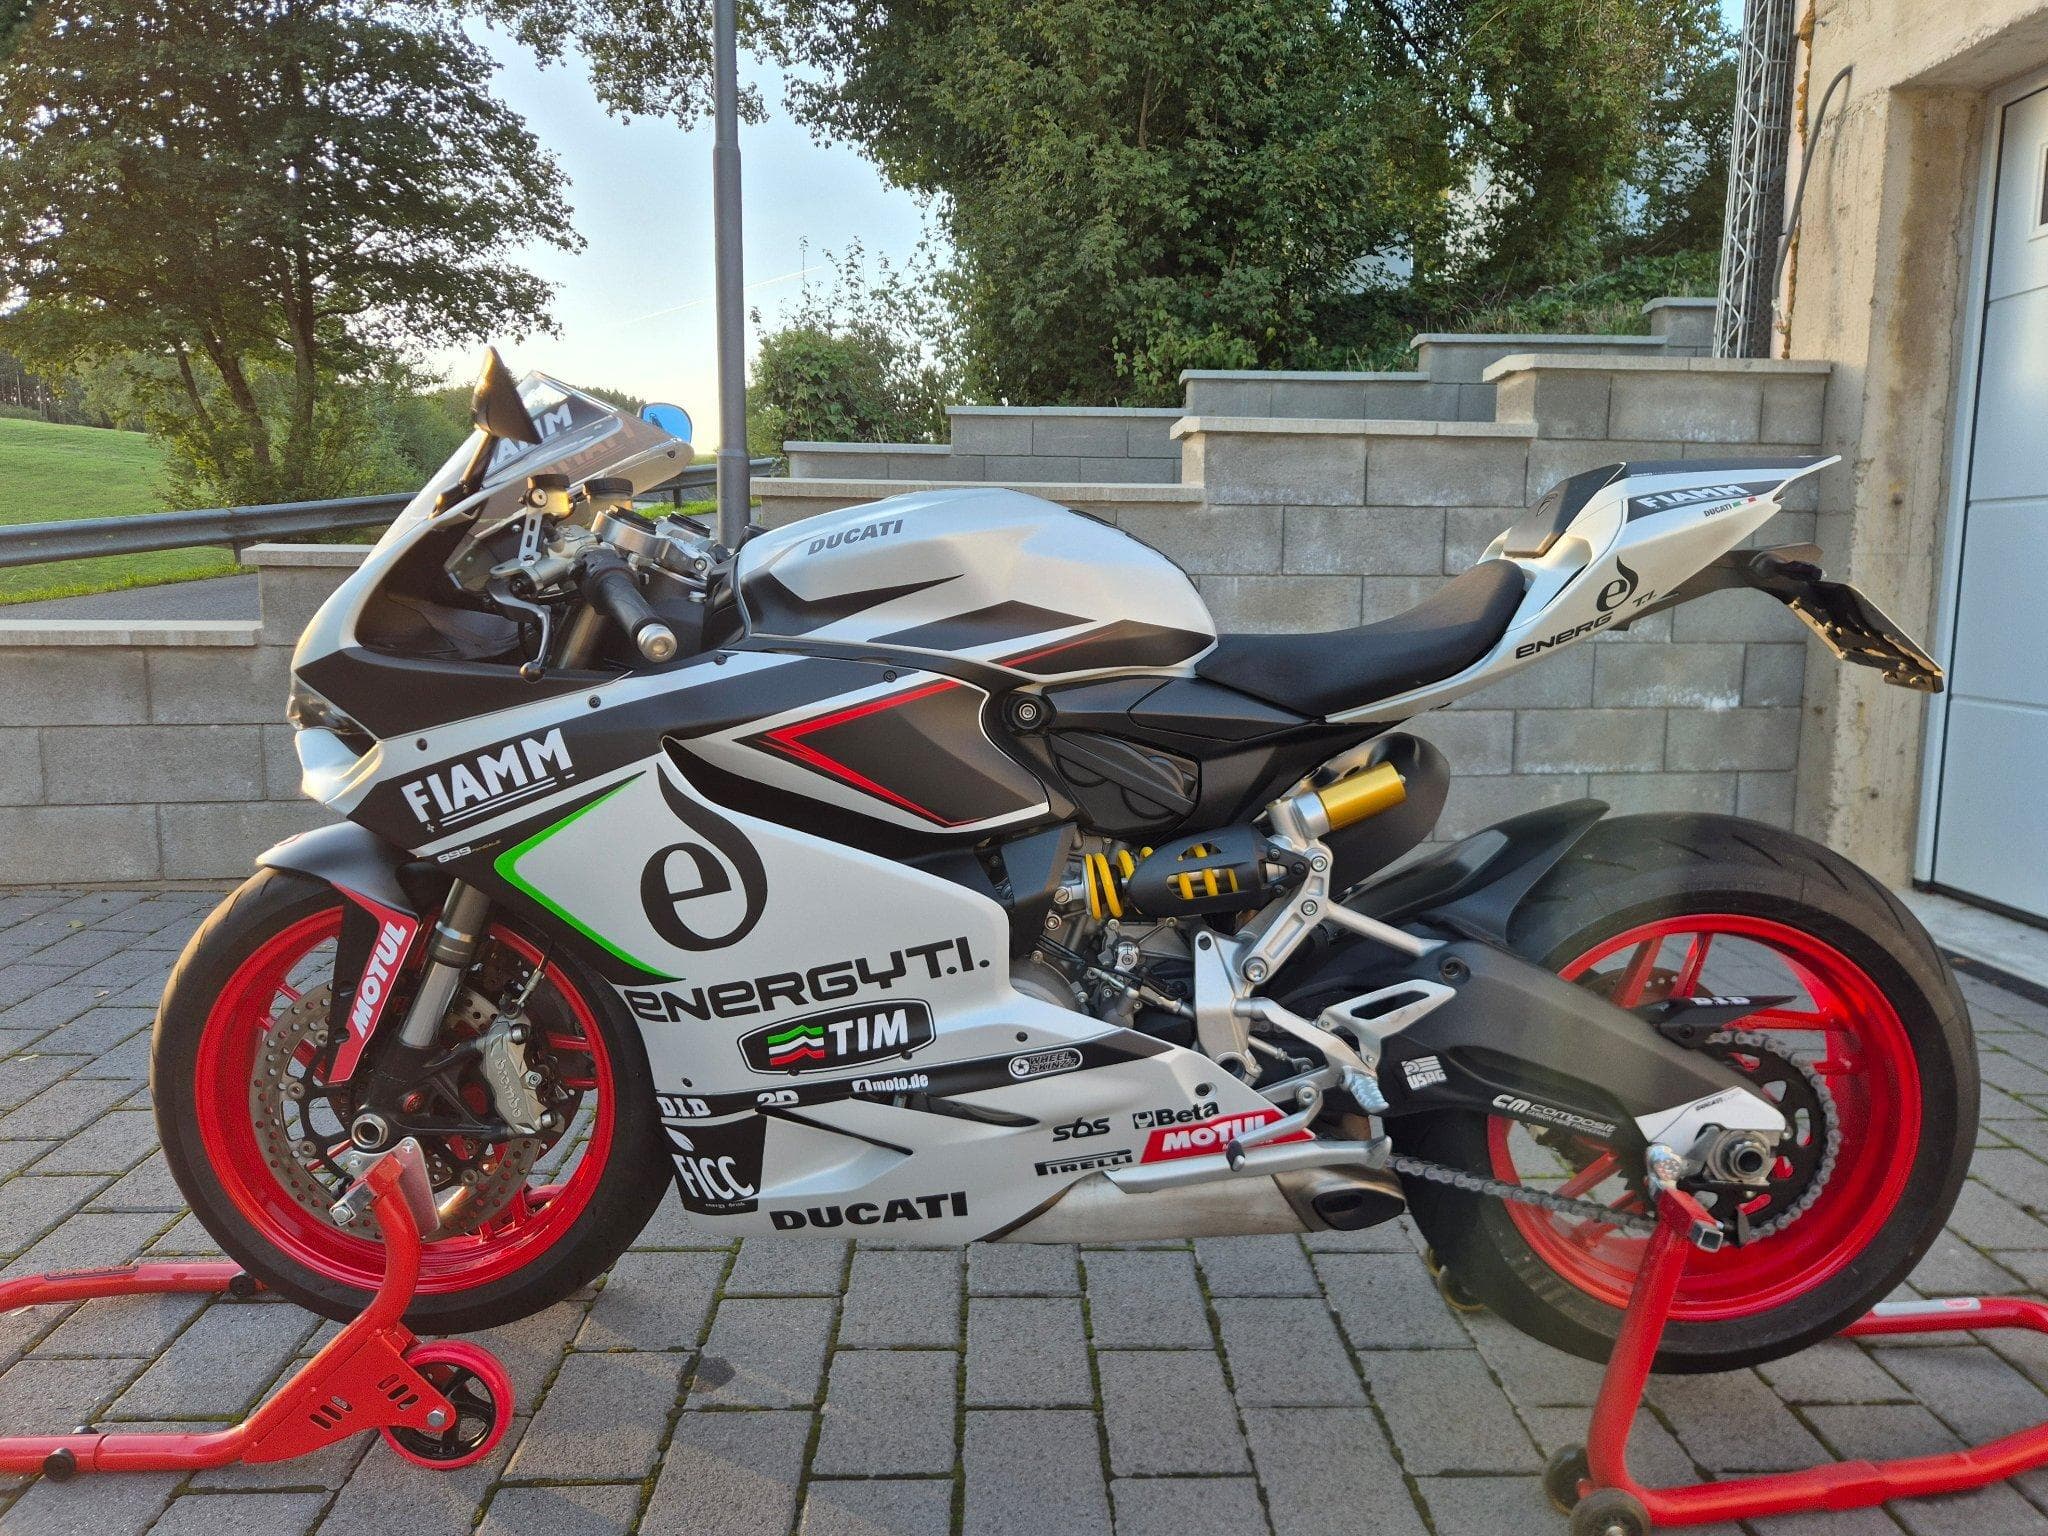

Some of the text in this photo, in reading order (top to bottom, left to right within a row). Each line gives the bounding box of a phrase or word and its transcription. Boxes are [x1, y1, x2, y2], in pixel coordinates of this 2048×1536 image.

[1636, 484, 1750, 508] FIAMM
[1703, 503, 1732, 517] DUCATI
[808, 520, 904, 555] DUCATI
[400, 727, 573, 823] FIAMM
[352, 921, 407, 1039] MOTUL
[828, 1008, 909, 1055] TIM
[1155, 1101, 1220, 1126] Beta
[671, 1153, 755, 1200] FICC
[1034, 1148, 1133, 1176] PIRELLI
[769, 1191, 968, 1231] DUCATI
